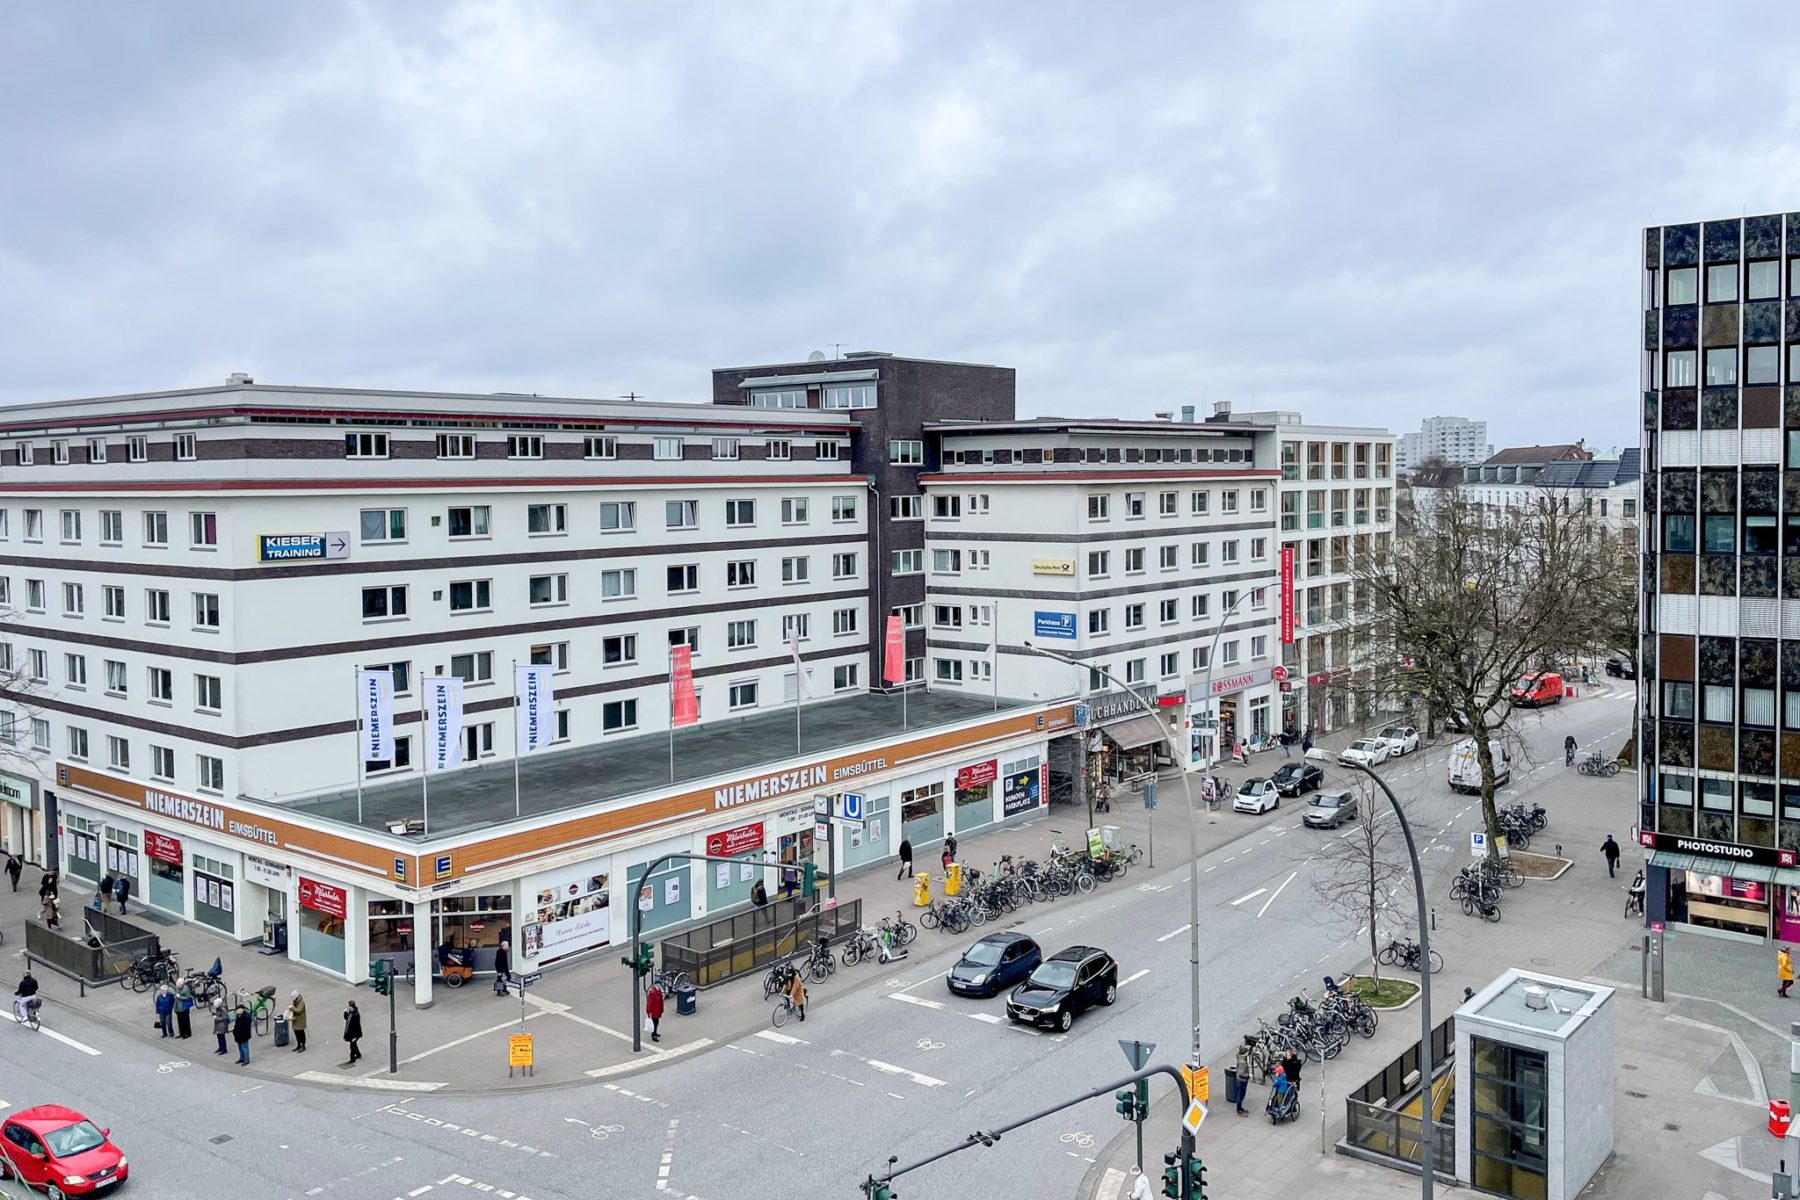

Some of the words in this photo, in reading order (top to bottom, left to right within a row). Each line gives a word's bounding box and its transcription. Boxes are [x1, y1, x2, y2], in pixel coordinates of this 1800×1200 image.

[266, 536, 320, 547] KIESER
[266, 548, 321, 558] TRAINING
[1037, 618, 1060, 626] Parkhaus
[1212, 674, 1254, 694] ROSSMANN
[369, 678, 380, 751] NIEMERSZEIN
[528, 672, 538, 744] NIEMERSZEIN
[436, 685, 447, 761] NIEMERSZEIN
[714, 765, 827, 809] NIEMERSZEIN
[833, 757, 888, 780] EIMSBÜTTEL
[846, 795, 860, 818] U
[1005, 791, 1025, 803] KUNDEN
[1005, 797, 1031, 811] PARKPLATZ
[145, 790, 225, 830] NIEMERSZEIN
[229, 820, 279, 846] EIMSBÜTTEL
[779, 808, 798, 818] MONTAG
[800, 804, 815, 812] SONNA
[1677, 839, 1754, 858] PHOTOSTUDIO
